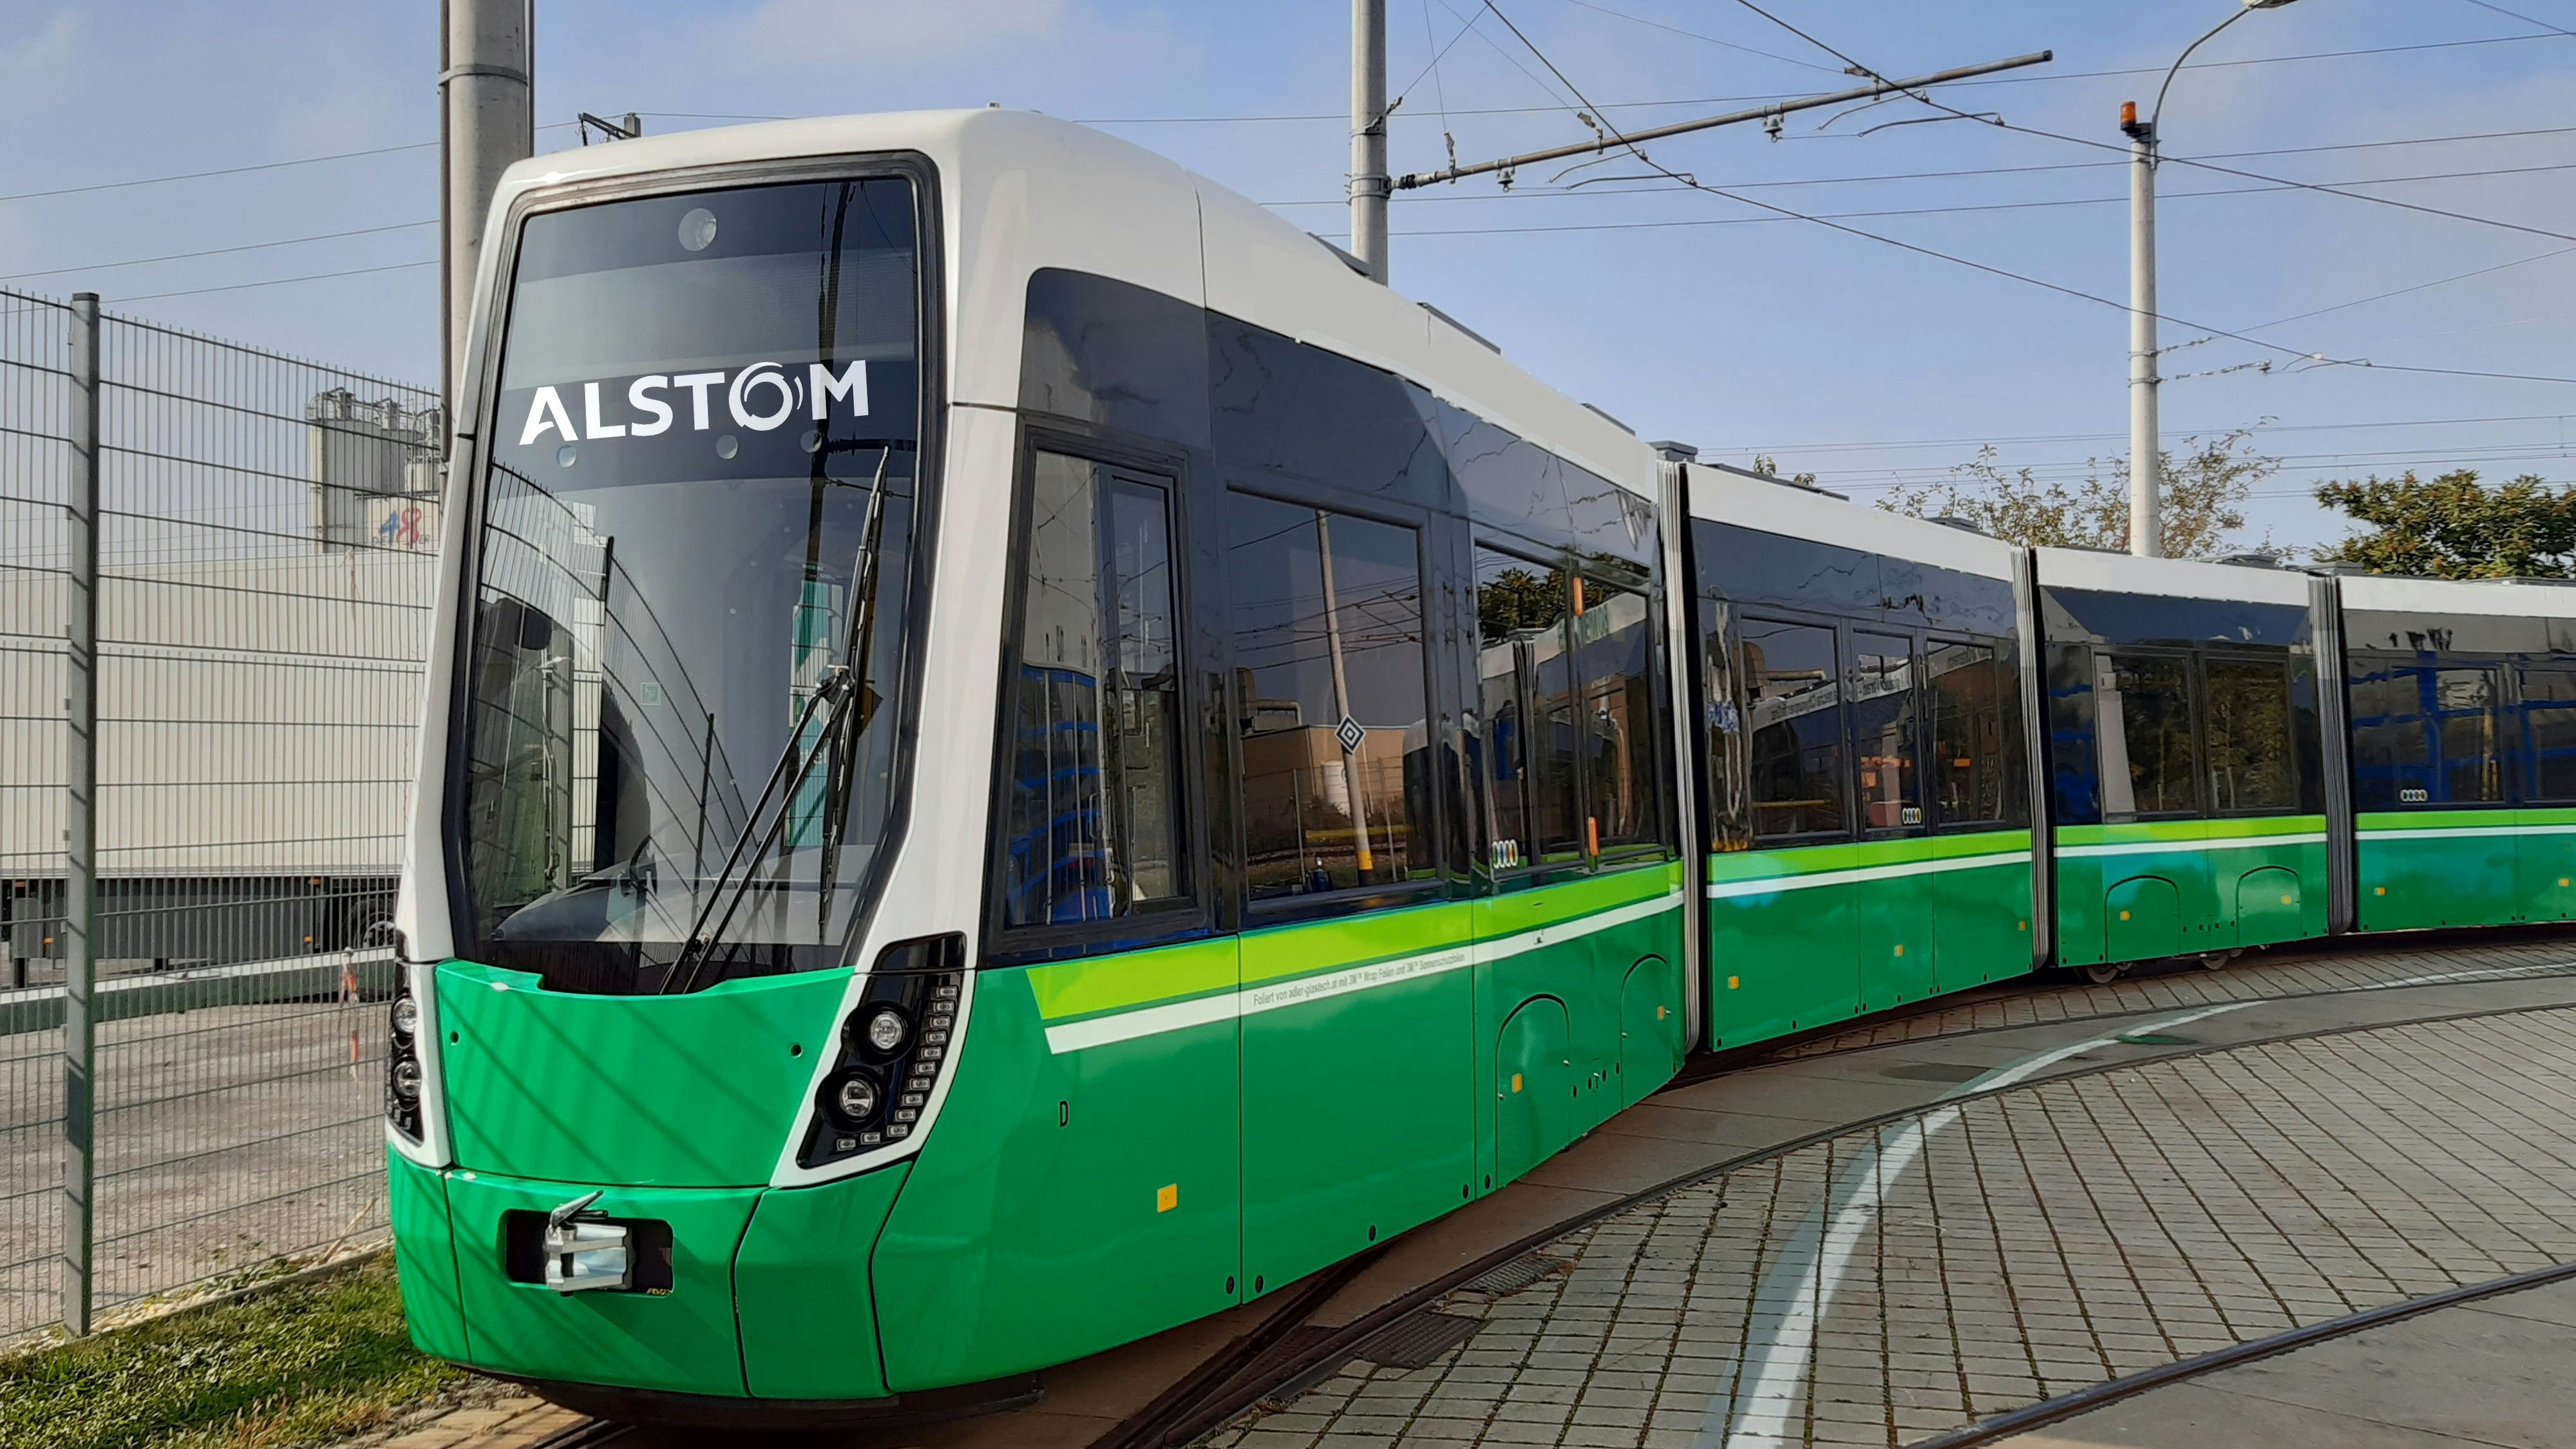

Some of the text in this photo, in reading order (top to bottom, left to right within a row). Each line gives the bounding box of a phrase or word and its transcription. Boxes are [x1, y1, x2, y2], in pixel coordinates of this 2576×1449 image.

[519, 360, 869, 446] ALSTOM
[1253, 992, 1274, 1006] Foliert
[1276, 990, 1287, 1000] von
[1059, 1101, 1069, 1128] D
